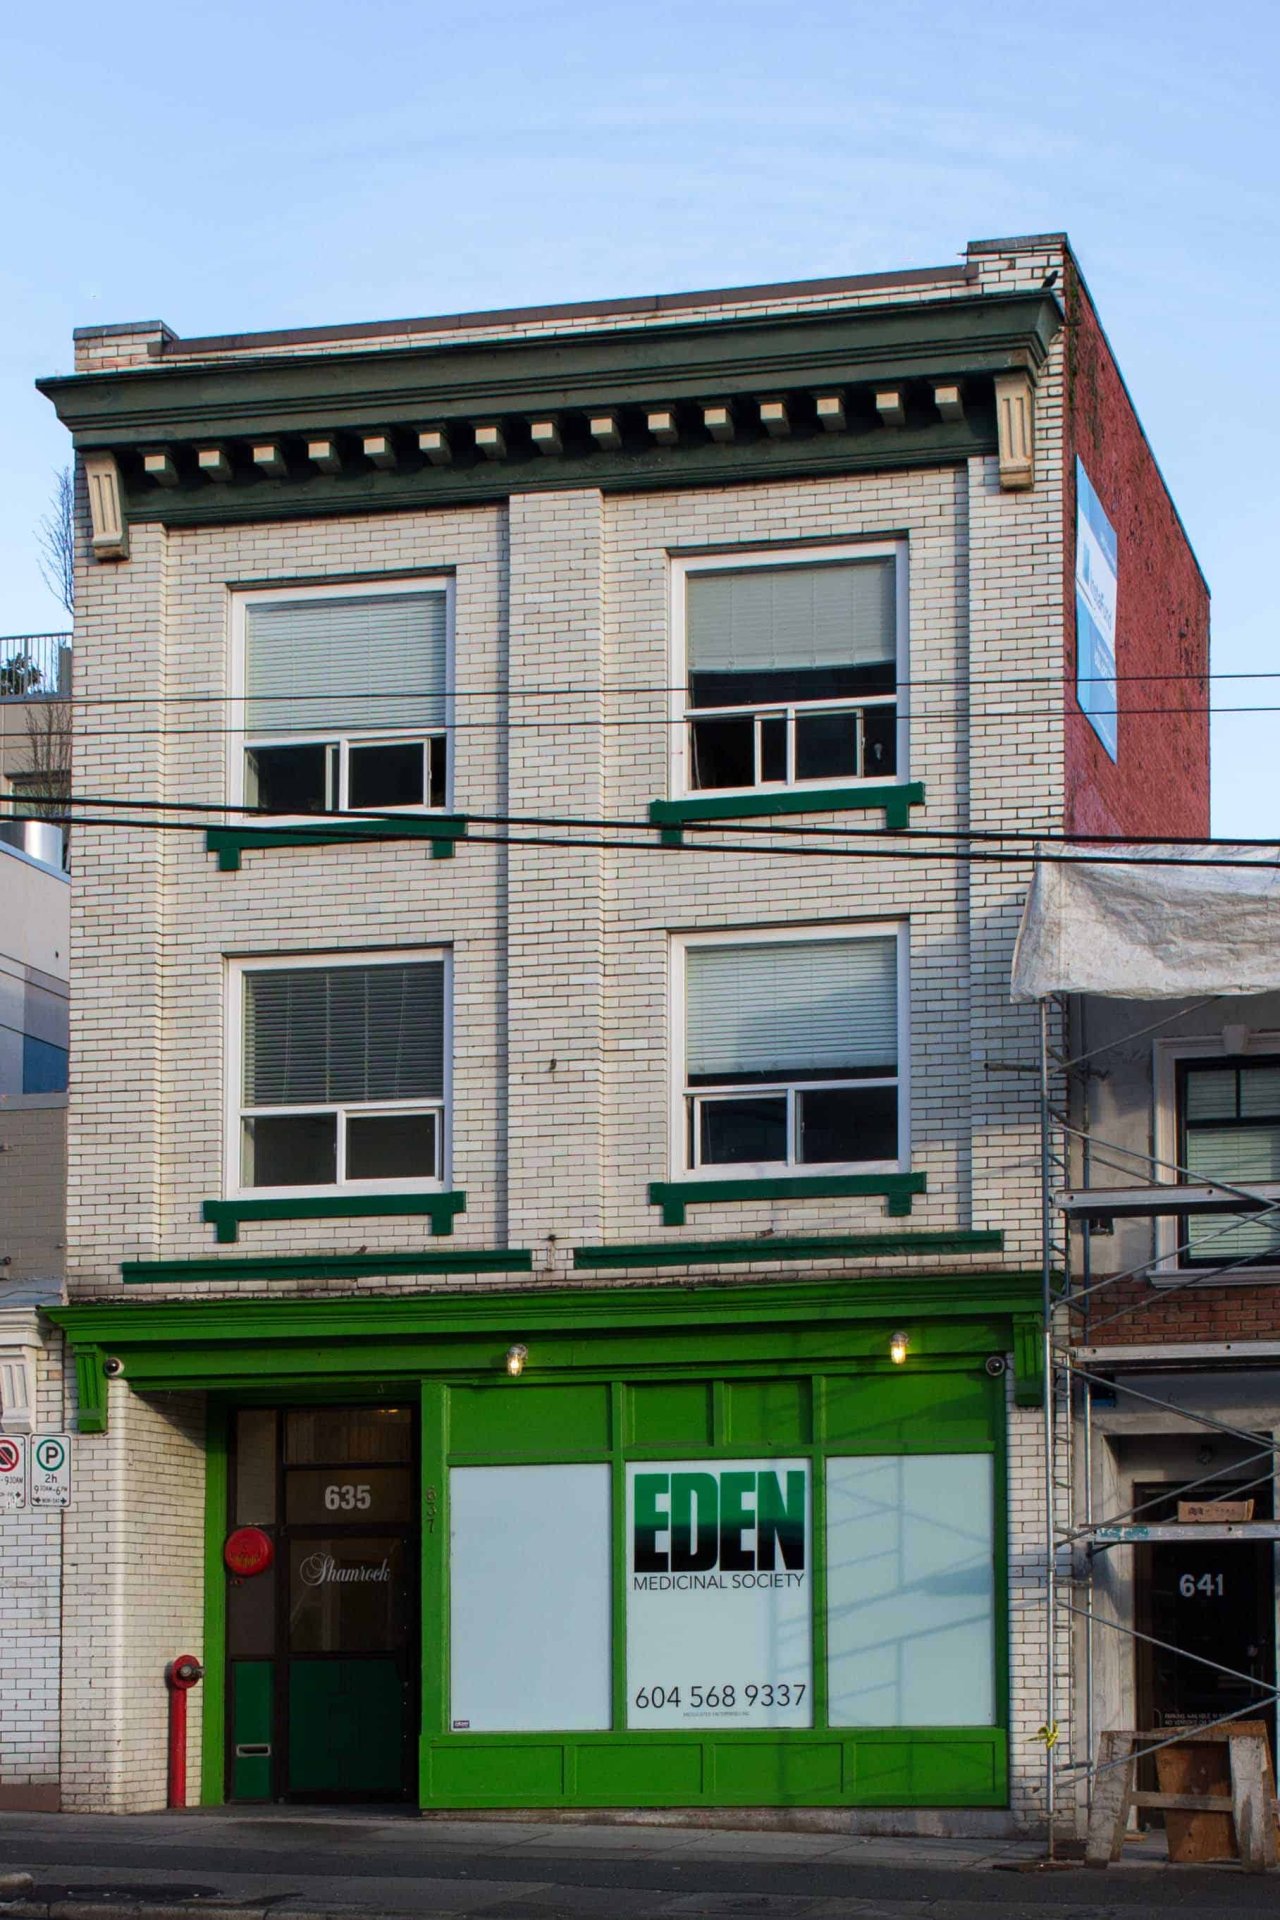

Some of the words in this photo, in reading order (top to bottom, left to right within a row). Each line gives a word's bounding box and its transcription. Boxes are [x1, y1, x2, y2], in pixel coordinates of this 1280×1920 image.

[45, 1473, 58, 1483] 2h
[324, 1484, 371, 1510] 635
[633, 1470, 806, 1573] EDEN
[299, 1552, 391, 1586] Shamrock
[633, 1575, 728, 1591] MEDICINAL
[732, 1573, 805, 1589] SOCIETY
[1179, 1573, 1224, 1597] 641
[635, 1686, 682, 1709] 604
[690, 1685, 736, 1708] 568
[744, 1684, 806, 1707] 9337
